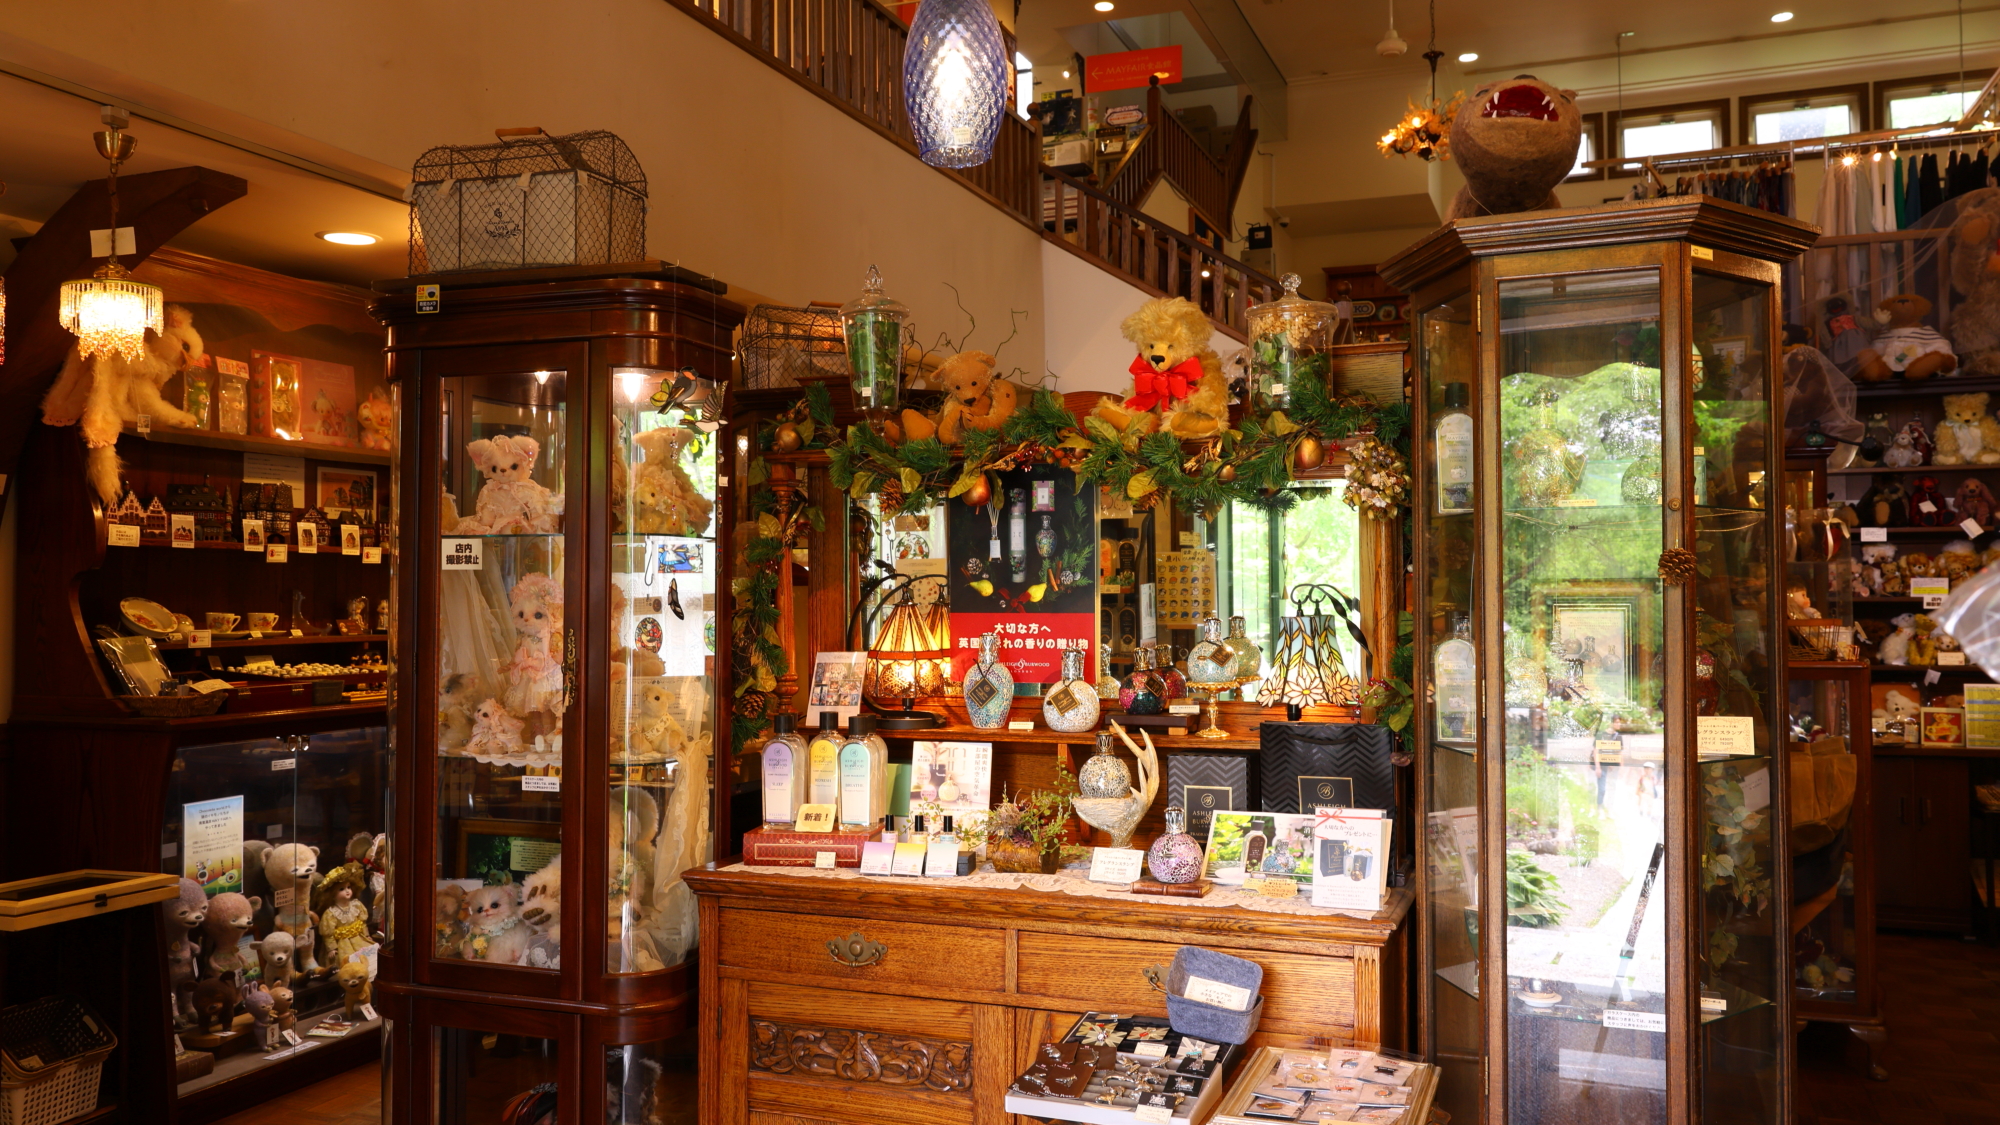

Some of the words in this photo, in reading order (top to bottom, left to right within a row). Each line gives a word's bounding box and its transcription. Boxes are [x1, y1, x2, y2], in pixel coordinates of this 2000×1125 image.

[455, 543, 472, 553] 店内
[446, 554, 479, 565] 撮影禁止
[994, 623, 1051, 634] 大切な方へ
[958, 638, 1089, 651] 英国れの香りの贈り物
